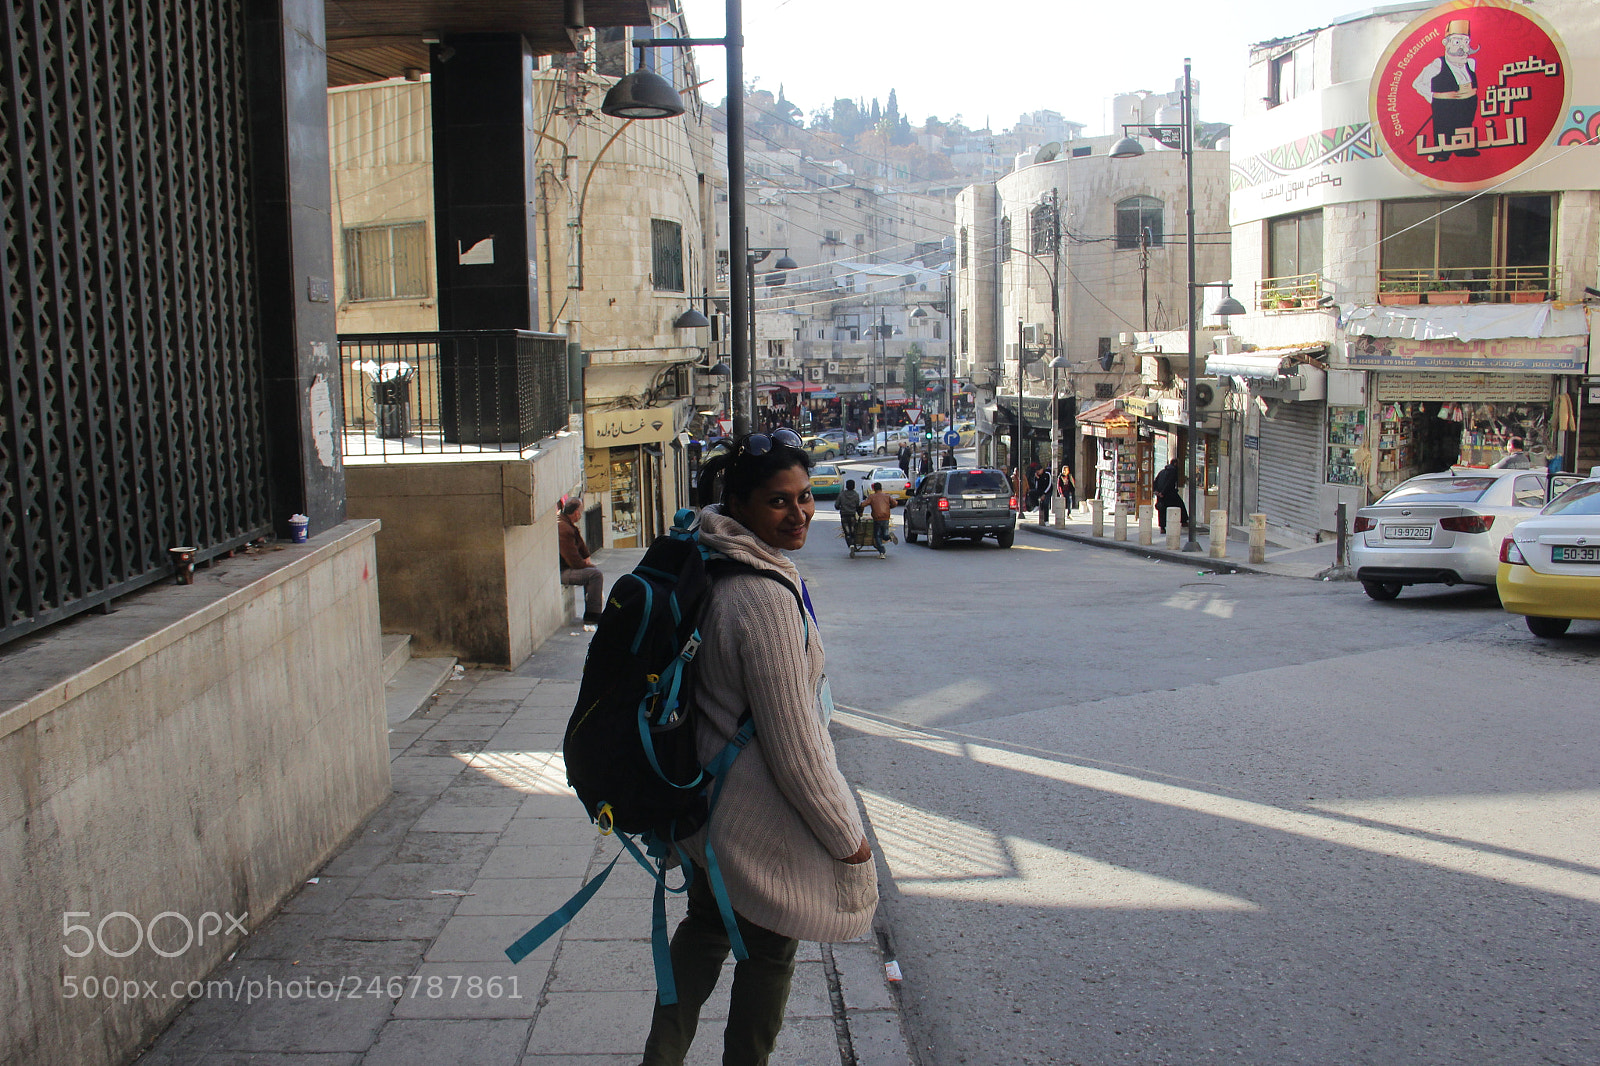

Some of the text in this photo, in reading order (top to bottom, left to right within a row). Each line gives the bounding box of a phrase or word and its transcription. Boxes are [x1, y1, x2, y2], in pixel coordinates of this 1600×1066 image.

[1398, 28, 1440, 70] Restaurant
[1499, 56, 1557, 86] مطعم
[1480, 85, 1529, 116] سوق
[1417, 117, 1525, 162] الذهب
[1286, 180, 1304, 202] سوق
[1307, 171, 1341, 196] مطعم
[1491, 340, 1577, 356] مطاحن
